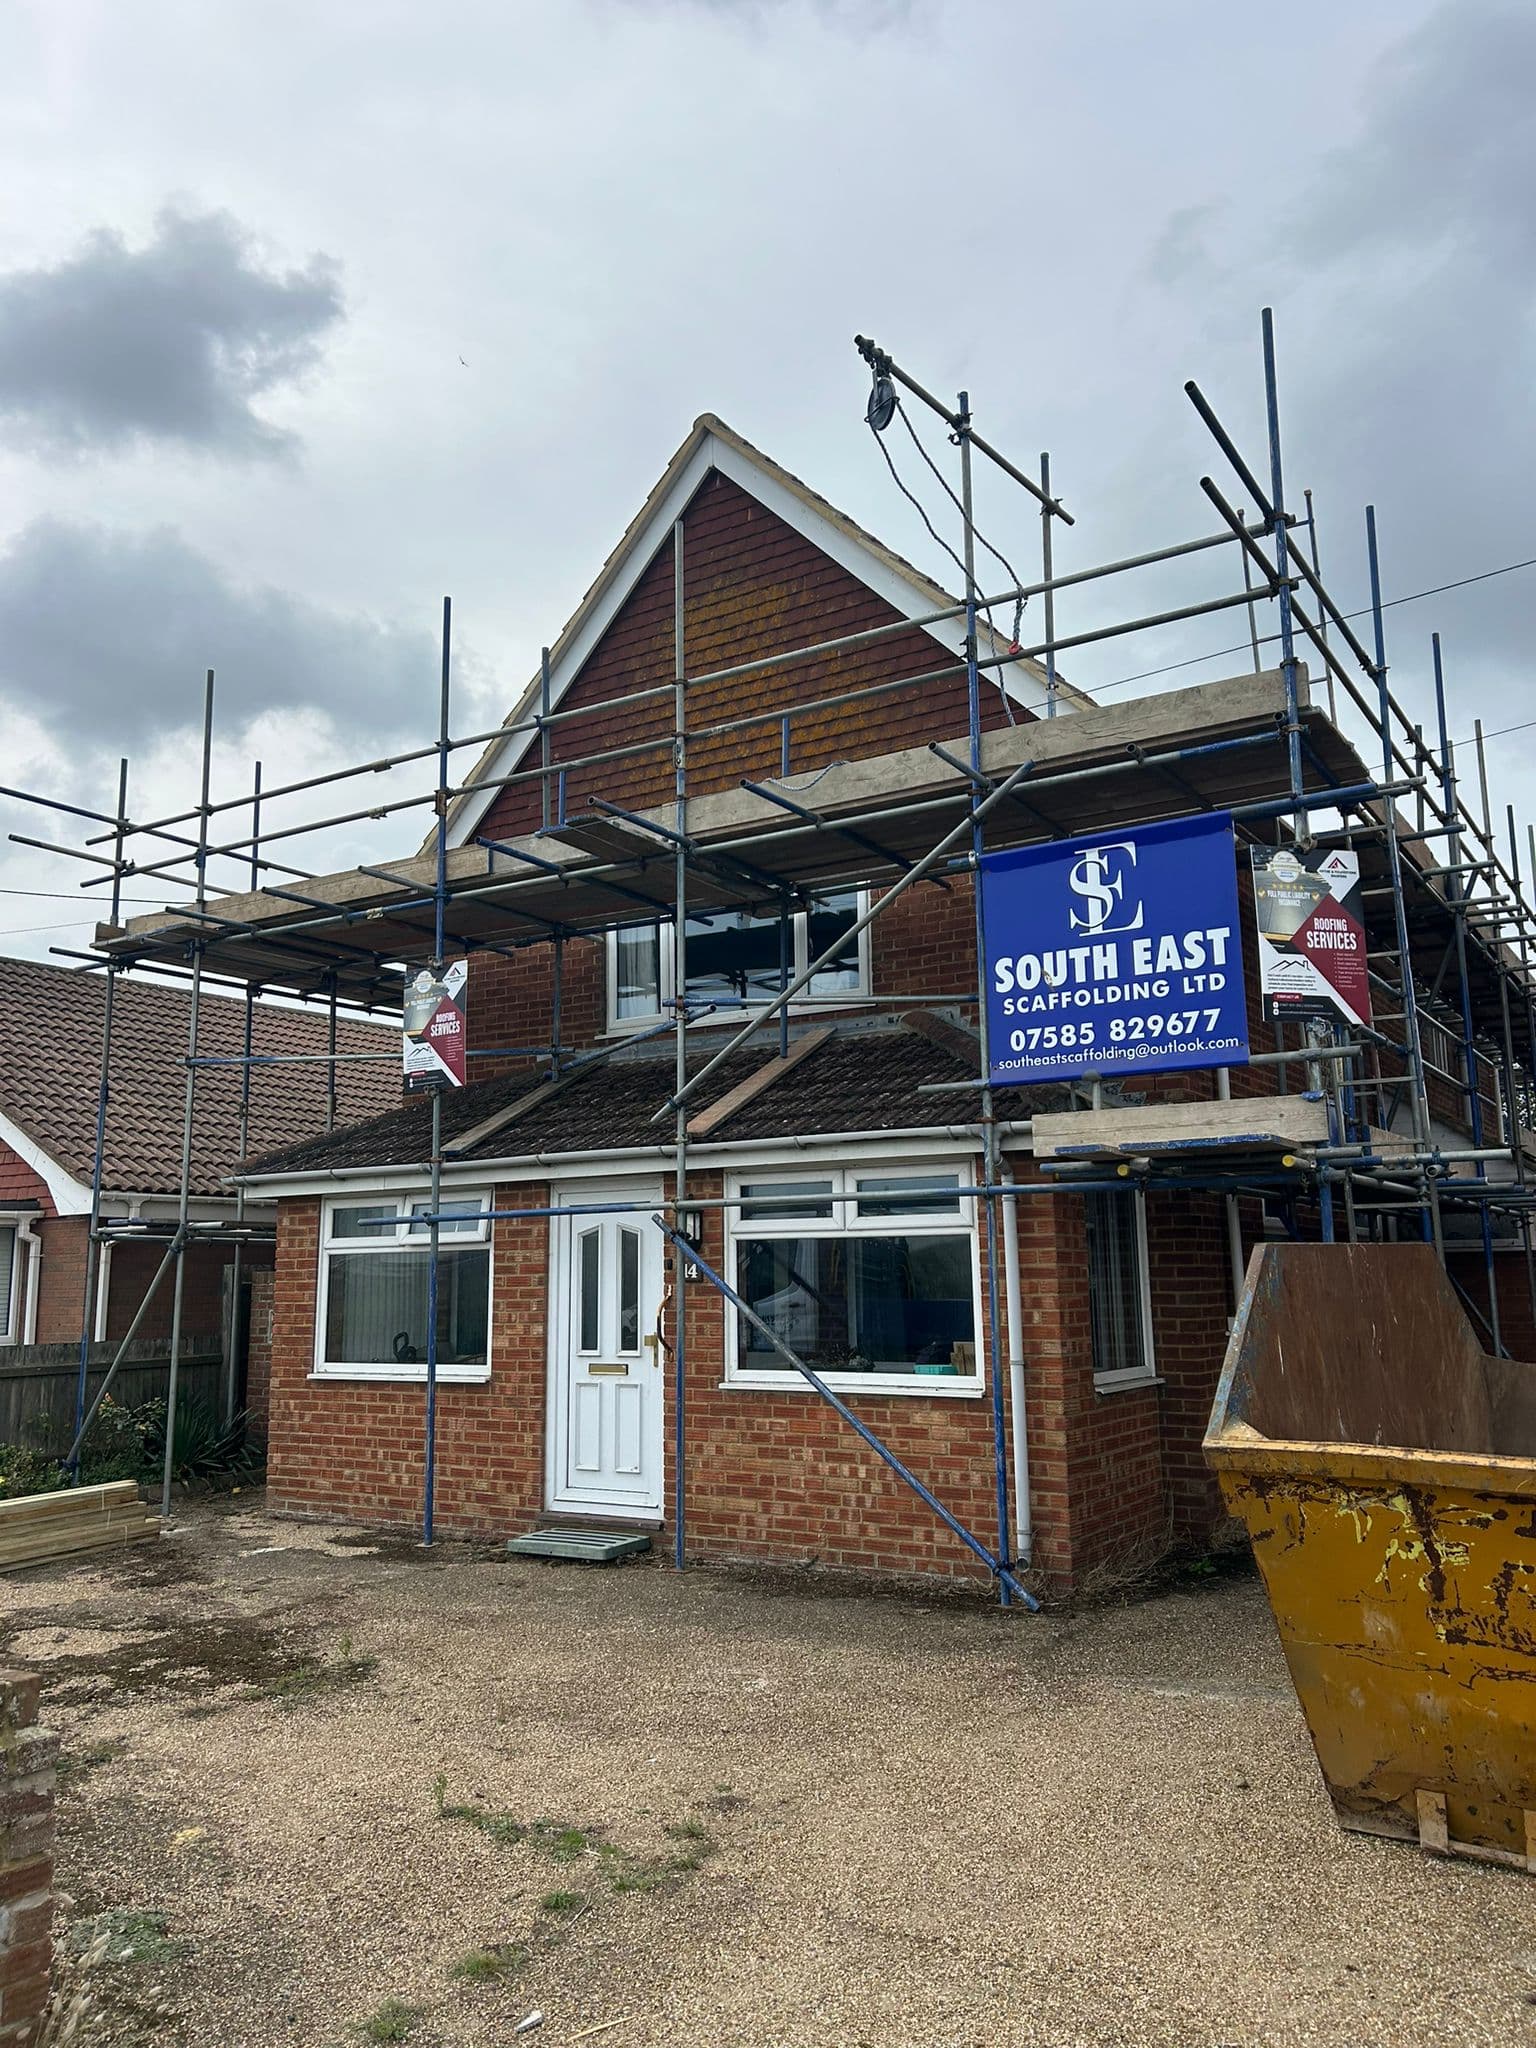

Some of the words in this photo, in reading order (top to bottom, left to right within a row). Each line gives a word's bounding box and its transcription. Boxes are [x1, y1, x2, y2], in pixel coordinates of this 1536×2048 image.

[1313, 917, 1348, 932] ROOFING
[1306, 930, 1358, 950] SERVICES
[994, 942, 1119, 994] SOUTH
[1132, 927, 1231, 976] EAST
[1003, 979, 1170, 1015] SCAFFOLDING
[1183, 973, 1226, 994] LTD
[435, 1012, 456, 1023] ROOFING
[431, 1021, 461, 1037] SERVICES
[1010, 1022, 1096, 1052] 07585
[1109, 1008, 1222, 1042] 829677
[998, 1037, 1240, 1070] southeastscaffolding@outlook.com
[684, 1263, 698, 1278] 14
